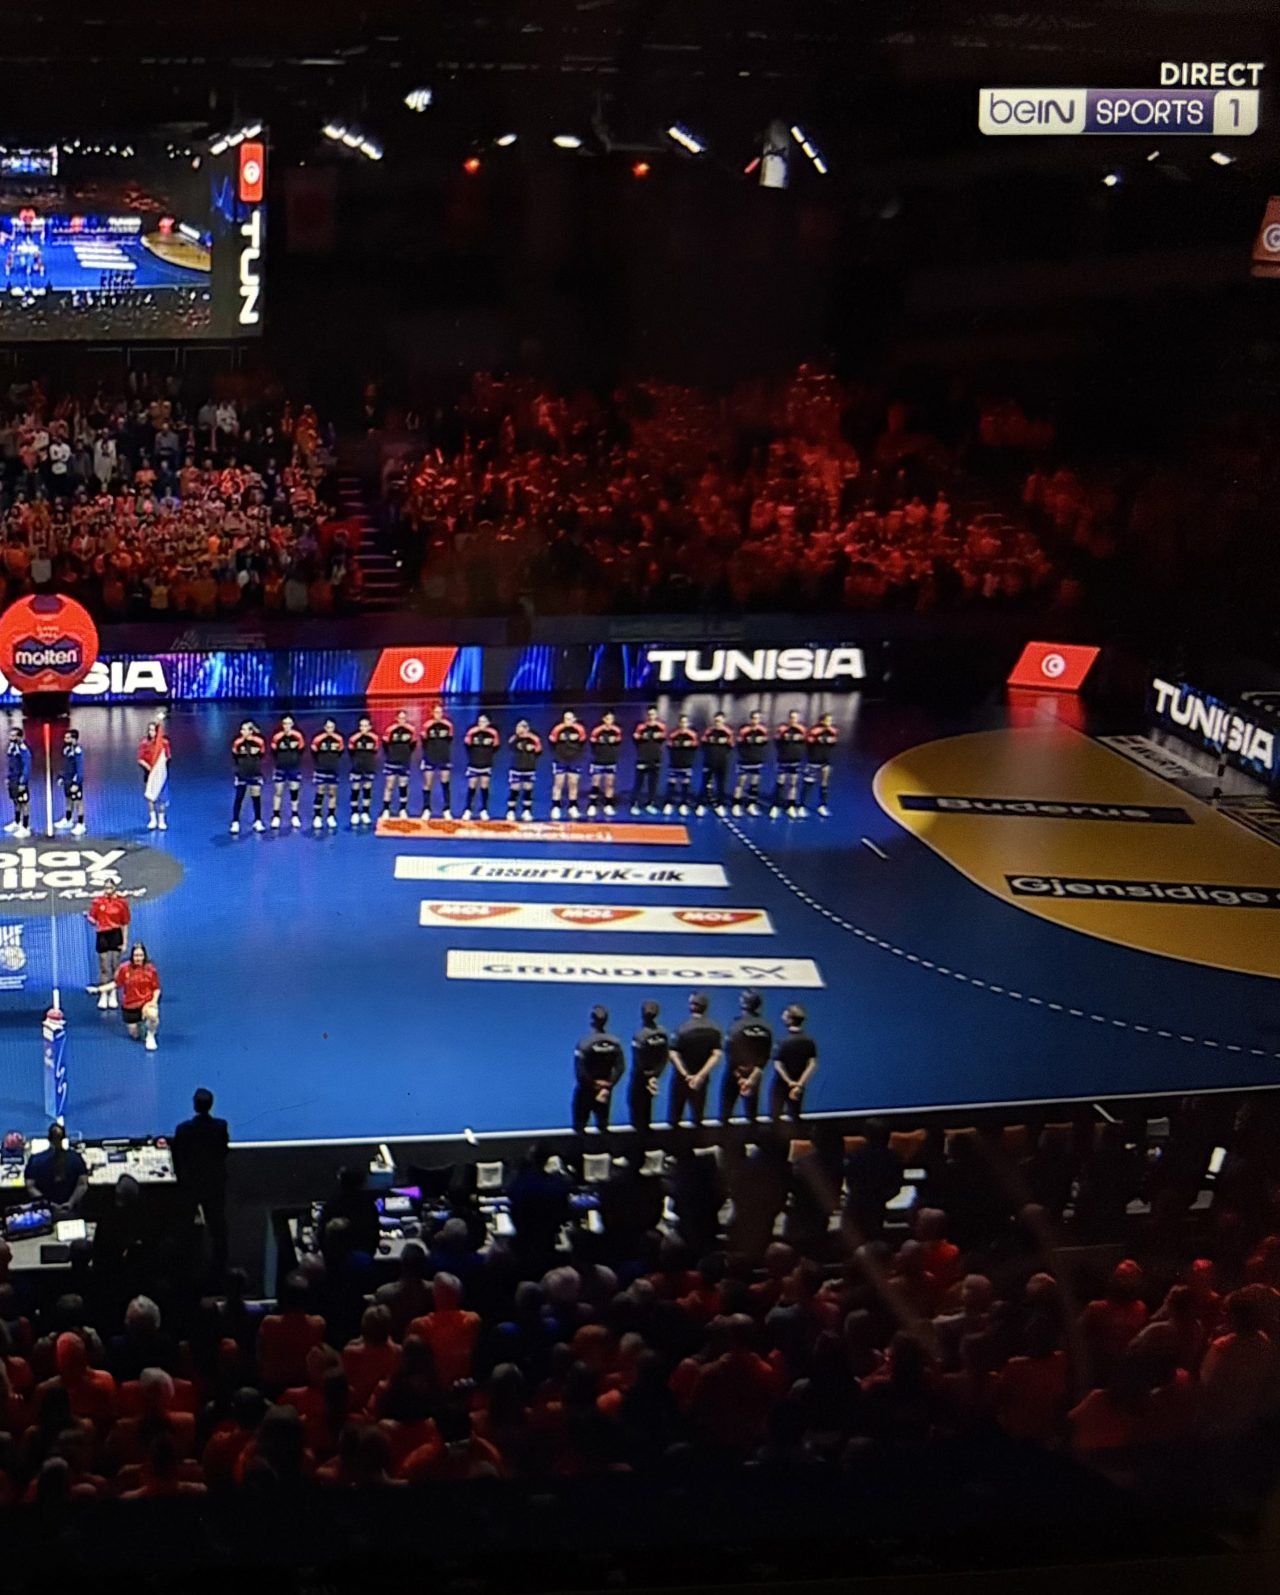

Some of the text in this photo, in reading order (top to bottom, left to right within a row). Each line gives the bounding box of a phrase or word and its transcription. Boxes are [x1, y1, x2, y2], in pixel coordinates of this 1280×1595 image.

[241, 210, 260, 325] TUN
[14, 649, 78, 666] molten
[646, 648, 867, 682] TUNISIA
[1151, 677, 1275, 770] TUNISIA
[1010, 877, 1269, 905] Gjensidige
[438, 904, 491, 916] MOL
[562, 907, 614, 919] MOL
[683, 910, 736, 922] MOL
[482, 963, 735, 979] GRUNDFOS
